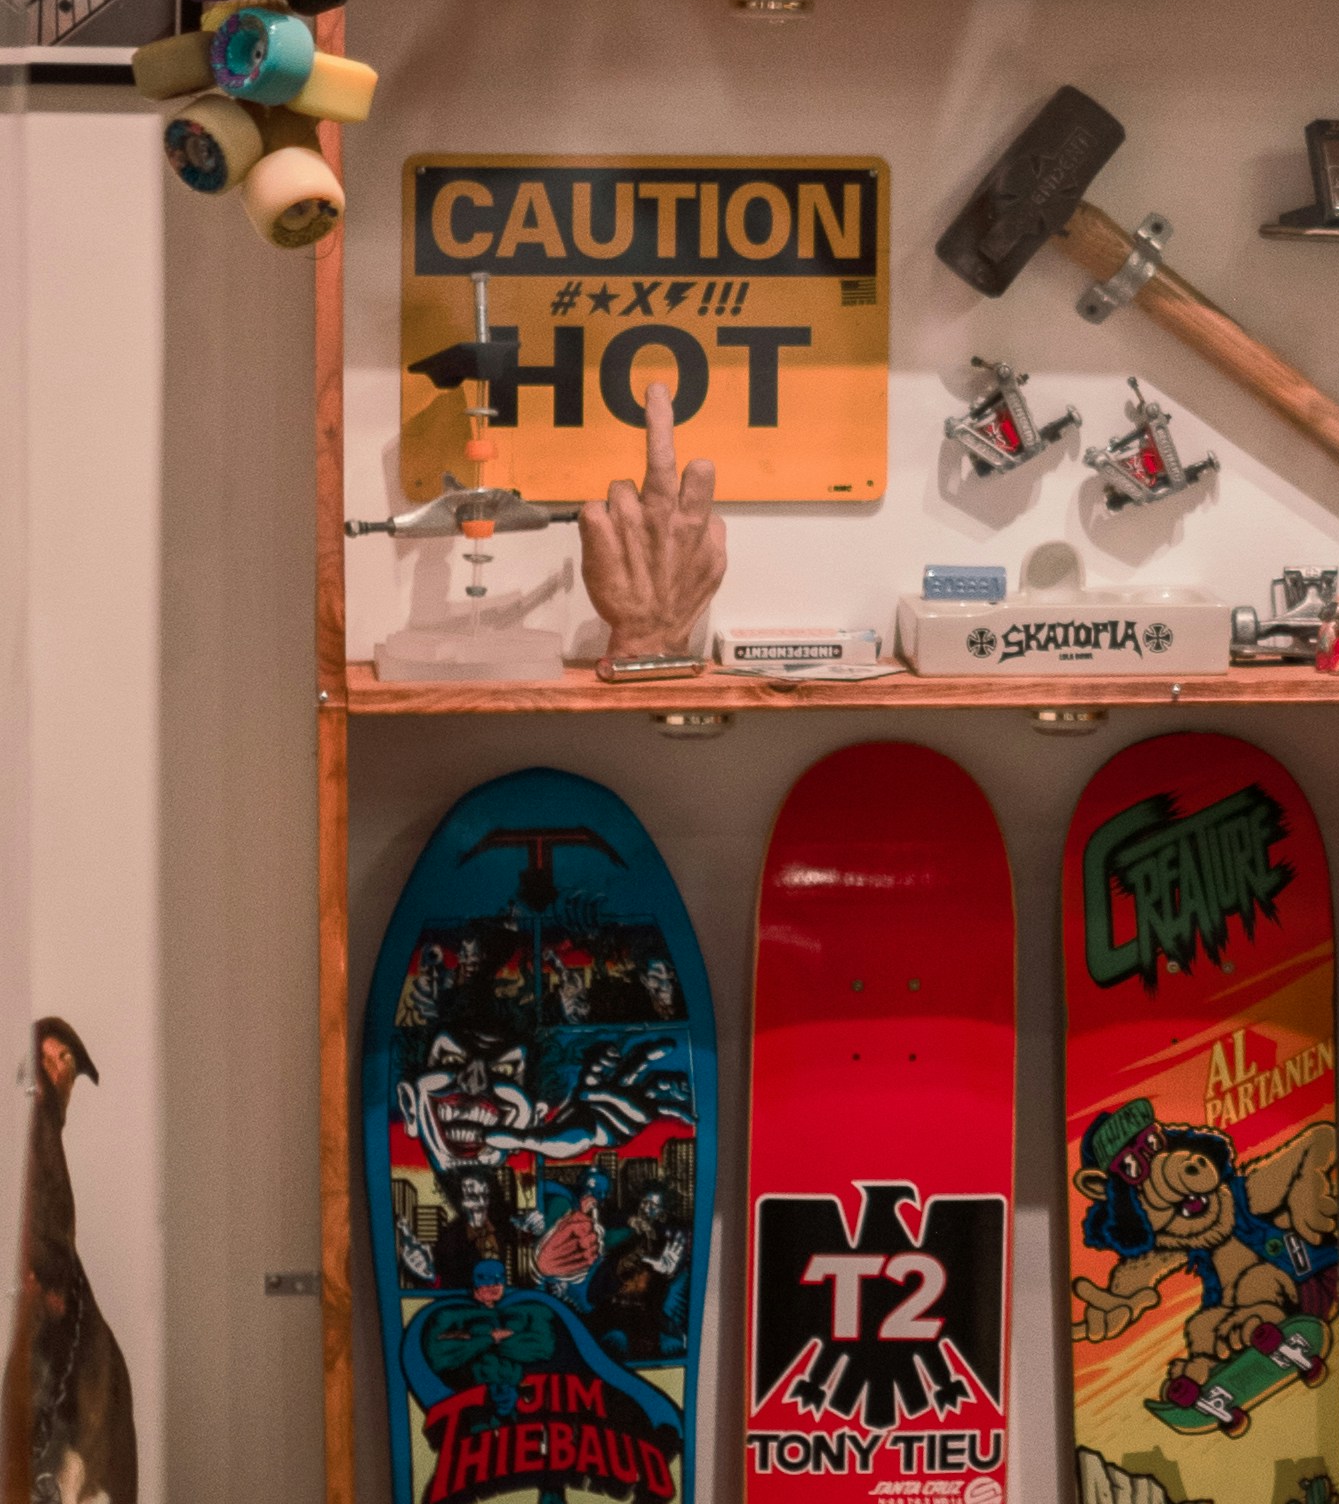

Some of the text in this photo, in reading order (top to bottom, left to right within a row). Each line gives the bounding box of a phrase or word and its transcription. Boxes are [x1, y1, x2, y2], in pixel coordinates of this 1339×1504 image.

[430, 181, 862, 262] CAUTION
[488, 323, 812, 430] HOT
[743, 644, 834, 660] INDEPENDENT
[998, 619, 1144, 665] SKATOPIA
[1082, 780, 1298, 993] CREATURE
[1204, 1027, 1258, 1100] AL
[1204, 1036, 1337, 1134] PARTANEN
[798, 1251, 948, 1342] T2
[515, 1372, 608, 1420] JIM
[747, 1427, 1005, 1475] TONY TIEU
